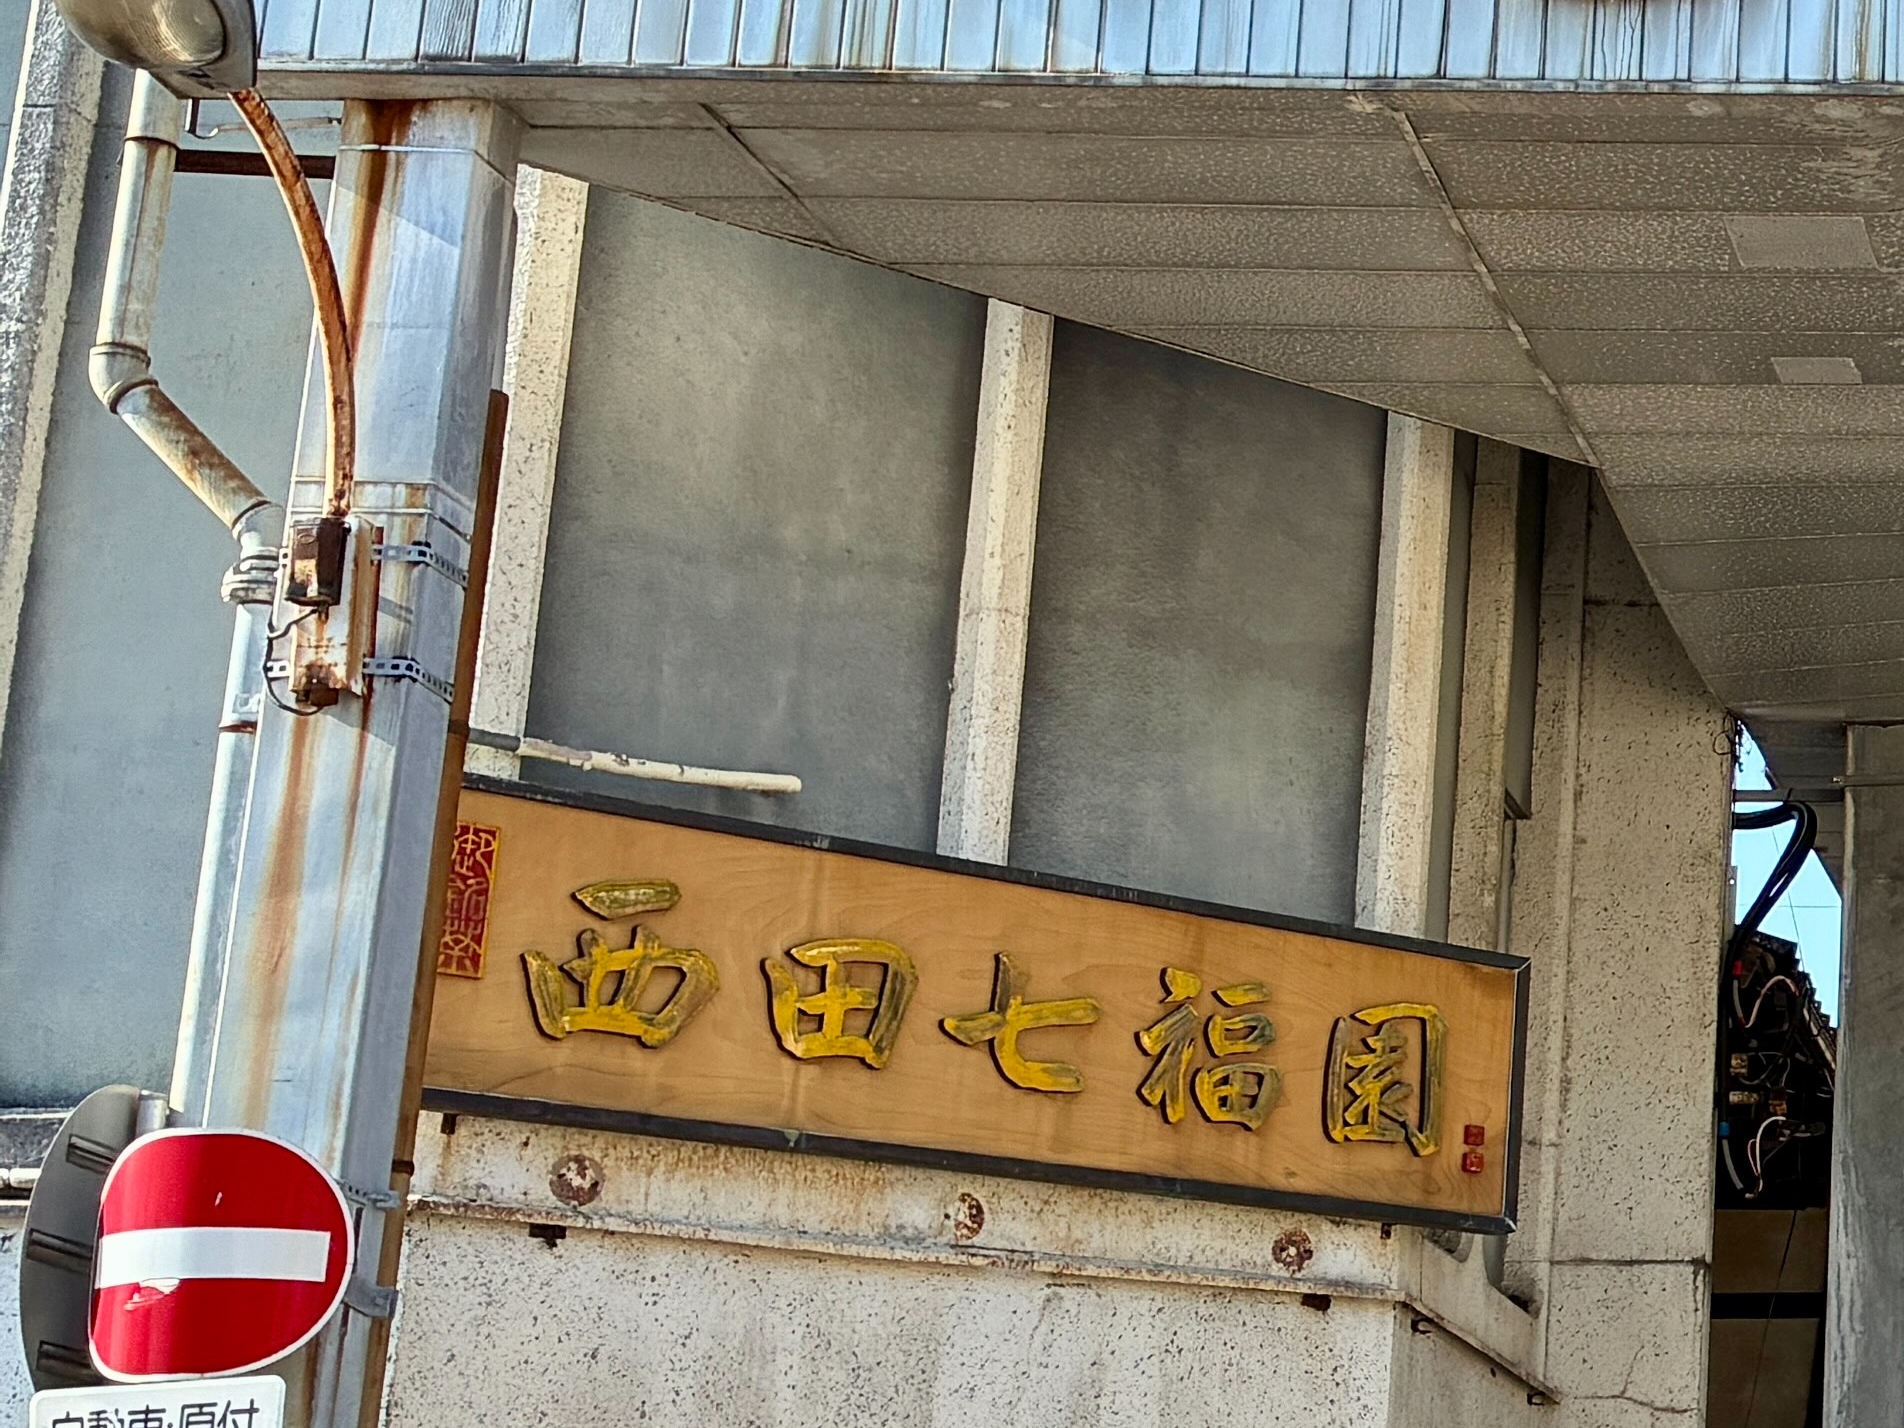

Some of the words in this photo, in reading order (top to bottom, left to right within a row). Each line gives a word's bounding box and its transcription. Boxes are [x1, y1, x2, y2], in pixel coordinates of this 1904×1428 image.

[521, 877, 1448, 1158] 西田七福園
